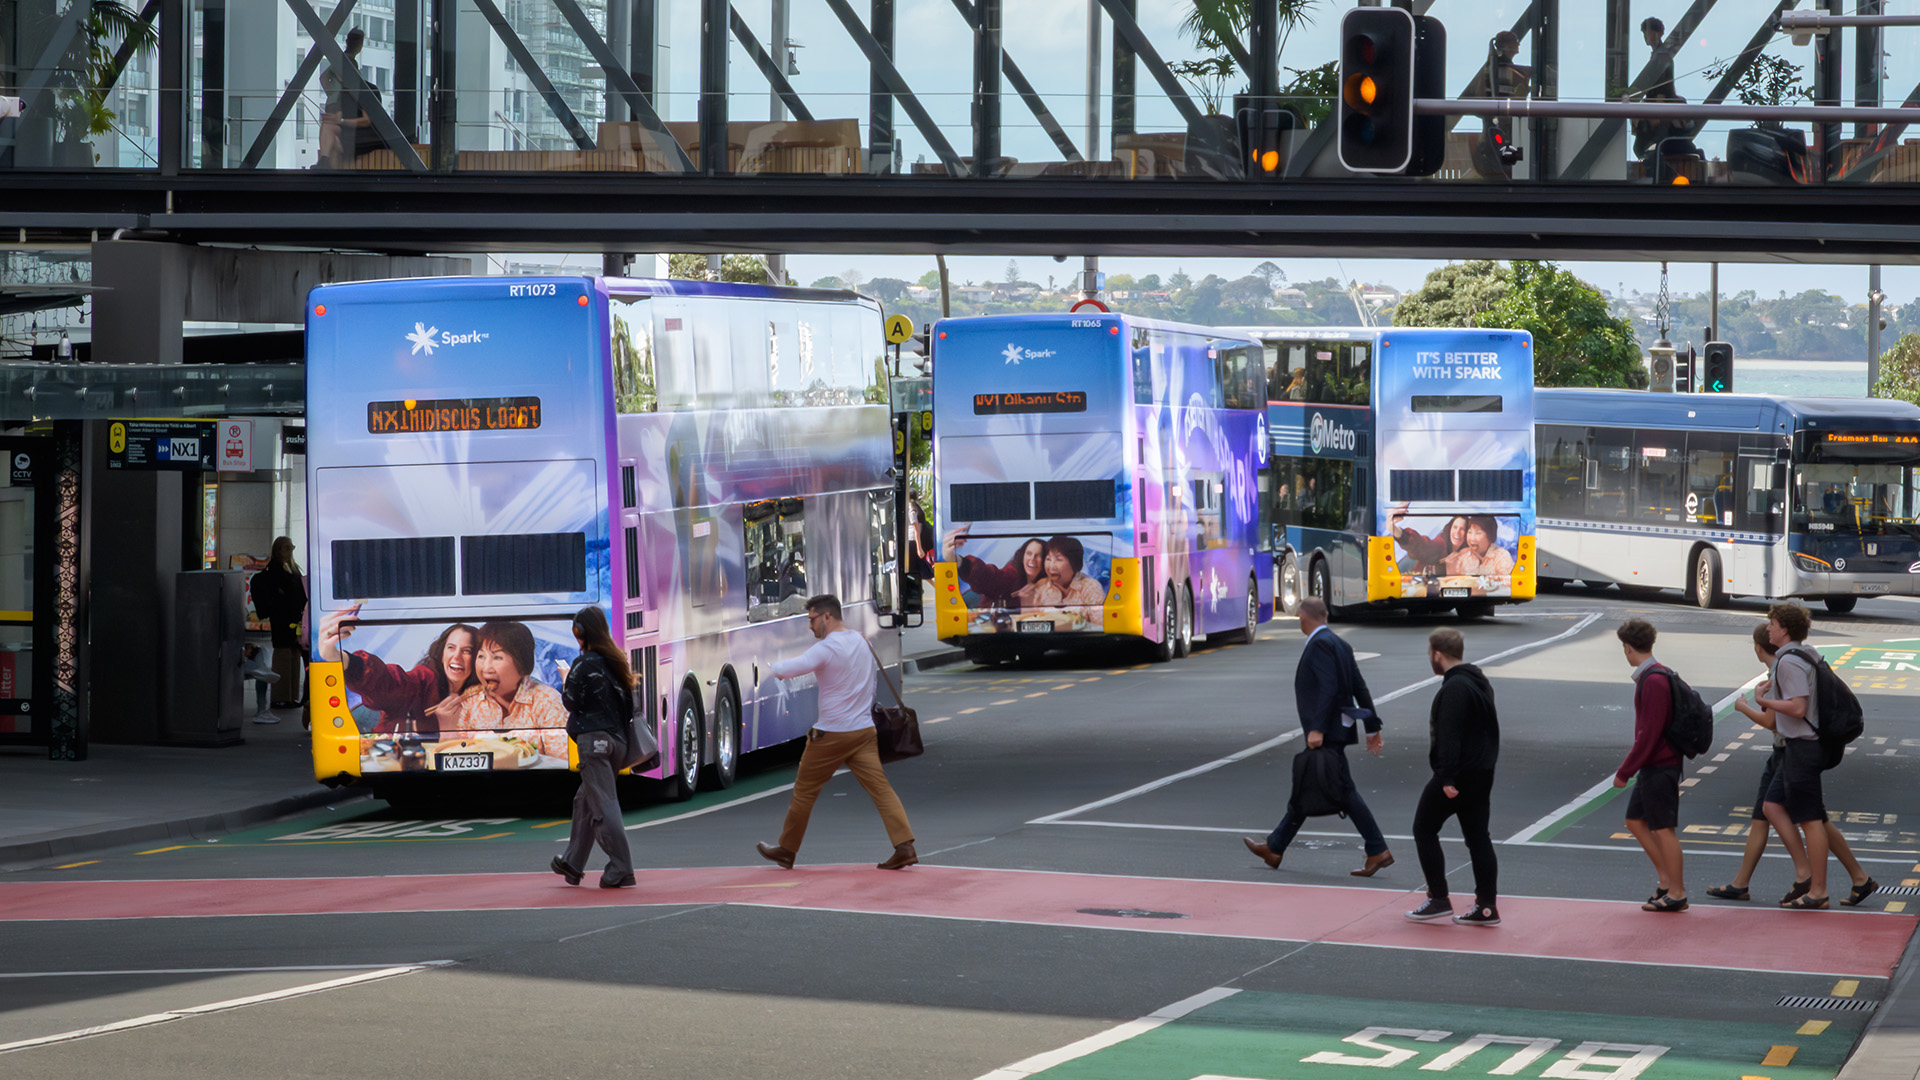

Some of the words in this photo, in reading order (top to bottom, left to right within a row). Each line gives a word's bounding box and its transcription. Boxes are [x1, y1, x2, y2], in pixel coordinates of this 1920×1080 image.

[510, 284, 556, 297] RT1073
[891, 321, 904, 337] A
[1071, 320, 1101, 328] RT1065
[441, 330, 482, 347] Spark
[1025, 349, 1051, 360] Spark
[1416, 352, 1440, 365] IT'S
[1444, 352, 1498, 365] BETTER
[1412, 366, 1451, 379] WITH
[1455, 366, 1502, 379] SPARK
[1322, 419, 1355, 451] Metro
[114, 440, 121, 448] A
[172, 442, 197, 457] NX1
[12, 470, 32, 478] CCTV
[444, 756, 487, 769] KAZ337
